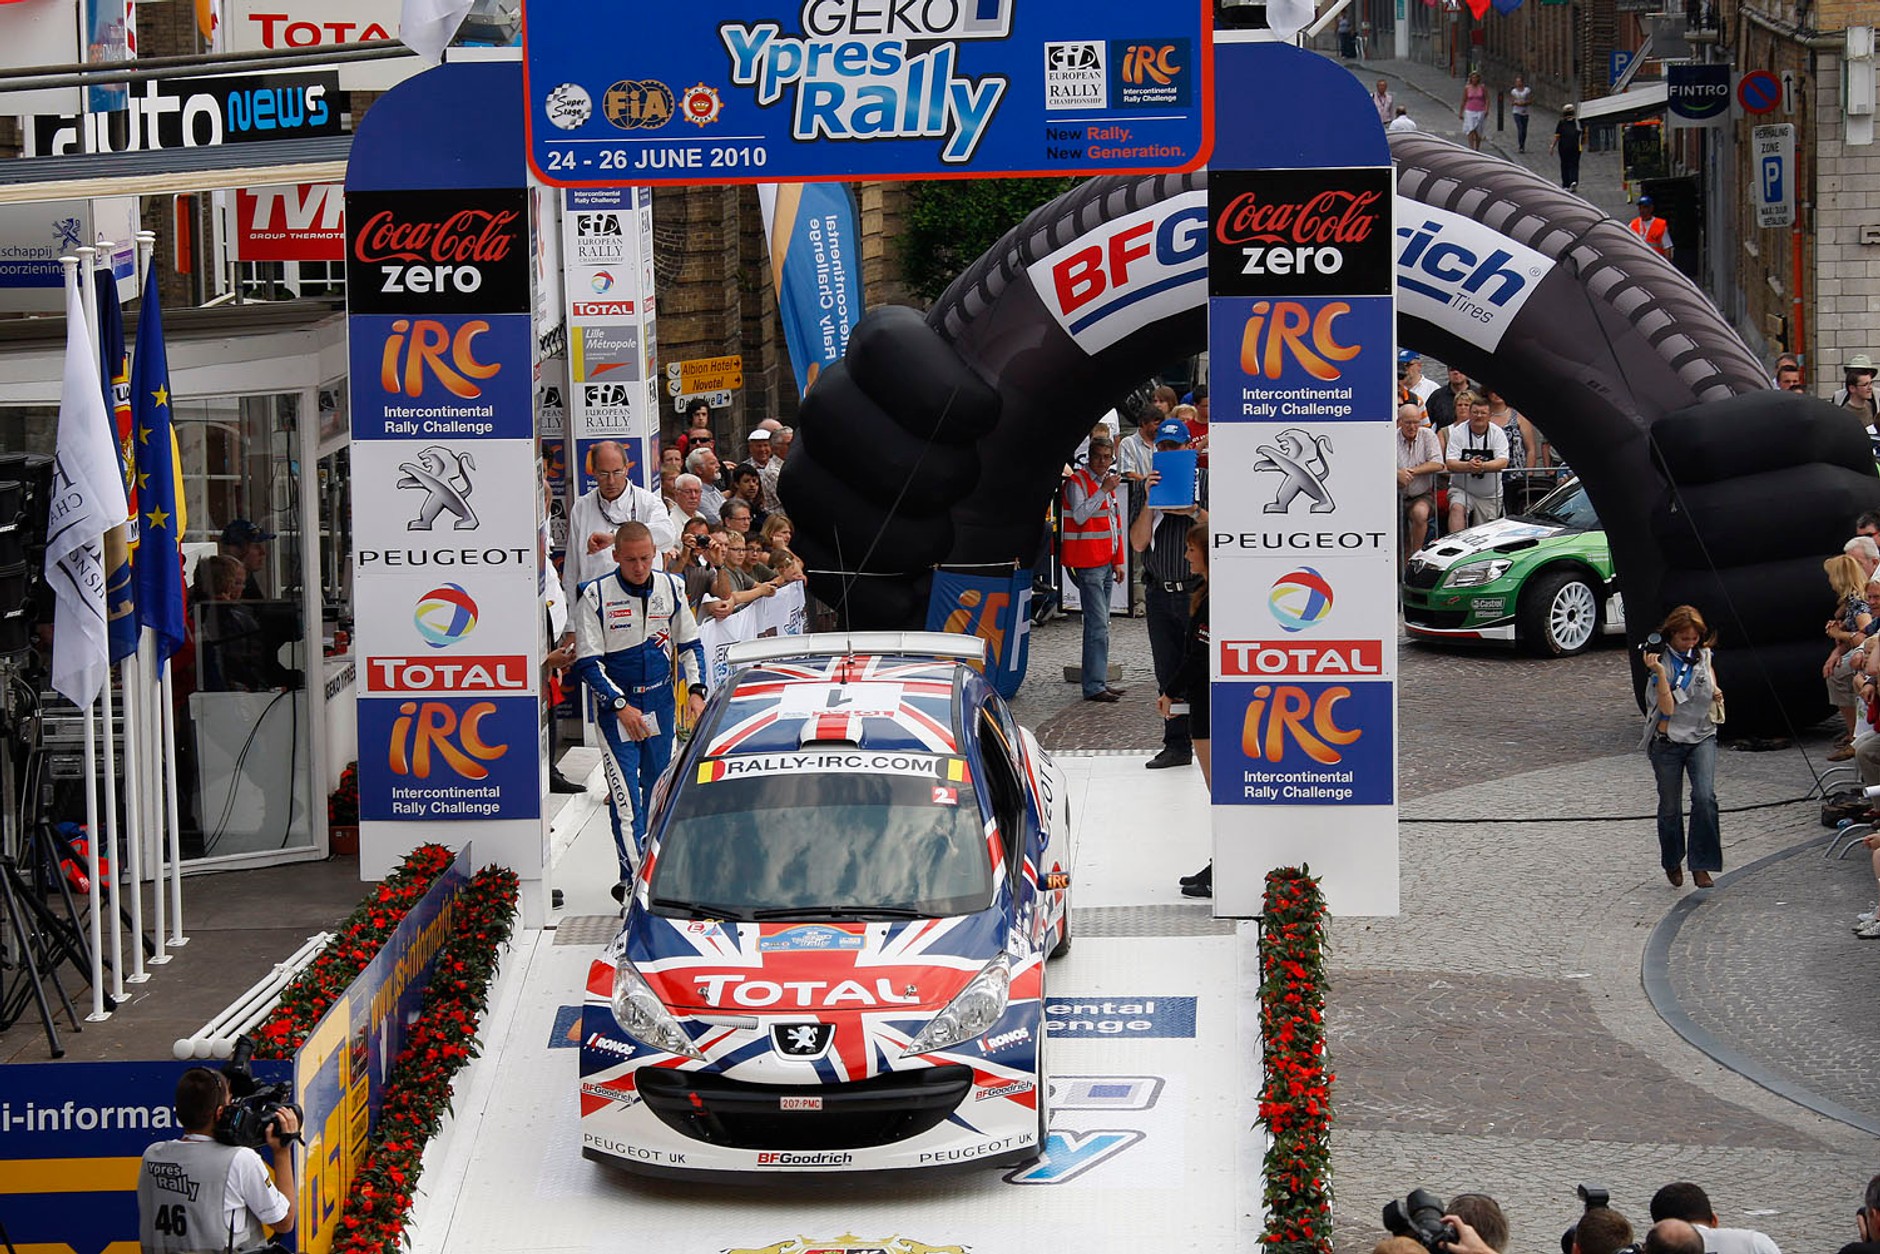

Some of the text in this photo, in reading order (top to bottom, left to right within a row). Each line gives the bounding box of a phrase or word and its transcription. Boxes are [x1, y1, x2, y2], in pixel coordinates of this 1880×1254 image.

[807, 0, 959, 35] GEKO
[249, 14, 400, 49] TOTA
[722, 27, 906, 102] Ypres
[1049, 72, 1102, 80] EUROPEAN
[1050, 84, 1102, 97] RALLY
[1123, 87, 1177, 95] Intercontinental
[1669, 84, 1728, 97] FINTRO
[559, 95, 586, 107] Super
[797, 47, 1003, 158] Rally
[1142, 95, 1177, 103] Challenge
[552, 107, 584, 118] Stage
[1046, 127, 1133, 142] New Rally.
[1047, 144, 1186, 159] New Generation.
[1762, 142, 1780, 153] ZONE
[547, 151, 576, 170] 24
[599, 150, 627, 169] 26
[635, 149, 703, 168] JUNE
[710, 148, 767, 167] 2010
[1216, 191, 1383, 245] Coca-Cola
[355, 210, 519, 263] Coca-Cola
[1, 246, 52, 259] schappij
[579, 246, 622, 256] RALLY
[1241, 246, 1343, 275] zero
[381, 265, 482, 293] zero
[575, 303, 633, 315] TOTAL
[1452, 292, 1494, 324] Tires
[585, 329, 605, 339] Lille
[586, 338, 637, 350] Métropole
[682, 360, 733, 375] Albion Hotel
[692, 377, 724, 391] Novotel
[1243, 388, 1352, 401] Intercontinental
[384, 405, 493, 417] Intercontinental
[1243, 403, 1352, 417] Rally Challenge
[385, 420, 493, 434] Rally Challenge
[586, 416, 630, 427] RALLY
[1215, 533, 1386, 549] PEUGEOT
[360, 549, 530, 566] PEUGEOT
[1227, 643, 1377, 673] TOTAL
[373, 659, 523, 689] TOTAL
[727, 756, 933, 774] RALLY-IRC.COM
[603, 752, 628, 808] PEUGEOT
[1244, 771, 1353, 784] Intercontinental
[392, 787, 500, 800] Intercontinental
[1245, 785, 1352, 800] Rally Challenge
[393, 801, 500, 816] Rally Challenge
[694, 975, 920, 1007] TOTAL
[1046, 1001, 1154, 1014] ental
[1046, 1020, 1152, 1033] enge
[586, 1032, 637, 1055] KRONOS
[976, 1027, 1029, 1051] KRONOS
[582, 1083, 633, 1102] BFGoodrich
[976, 1081, 1032, 1100] BFGoodrich
[584, 1133, 686, 1164] PEUGEOT UK
[919, 1132, 1033, 1163] PEUGEOT UK
[757, 1152, 855, 1164] BFGoodrich
[148, 1162, 181, 1176] Ypres
[158, 1176, 200, 1201] Rally
[155, 1204, 187, 1237] 46
